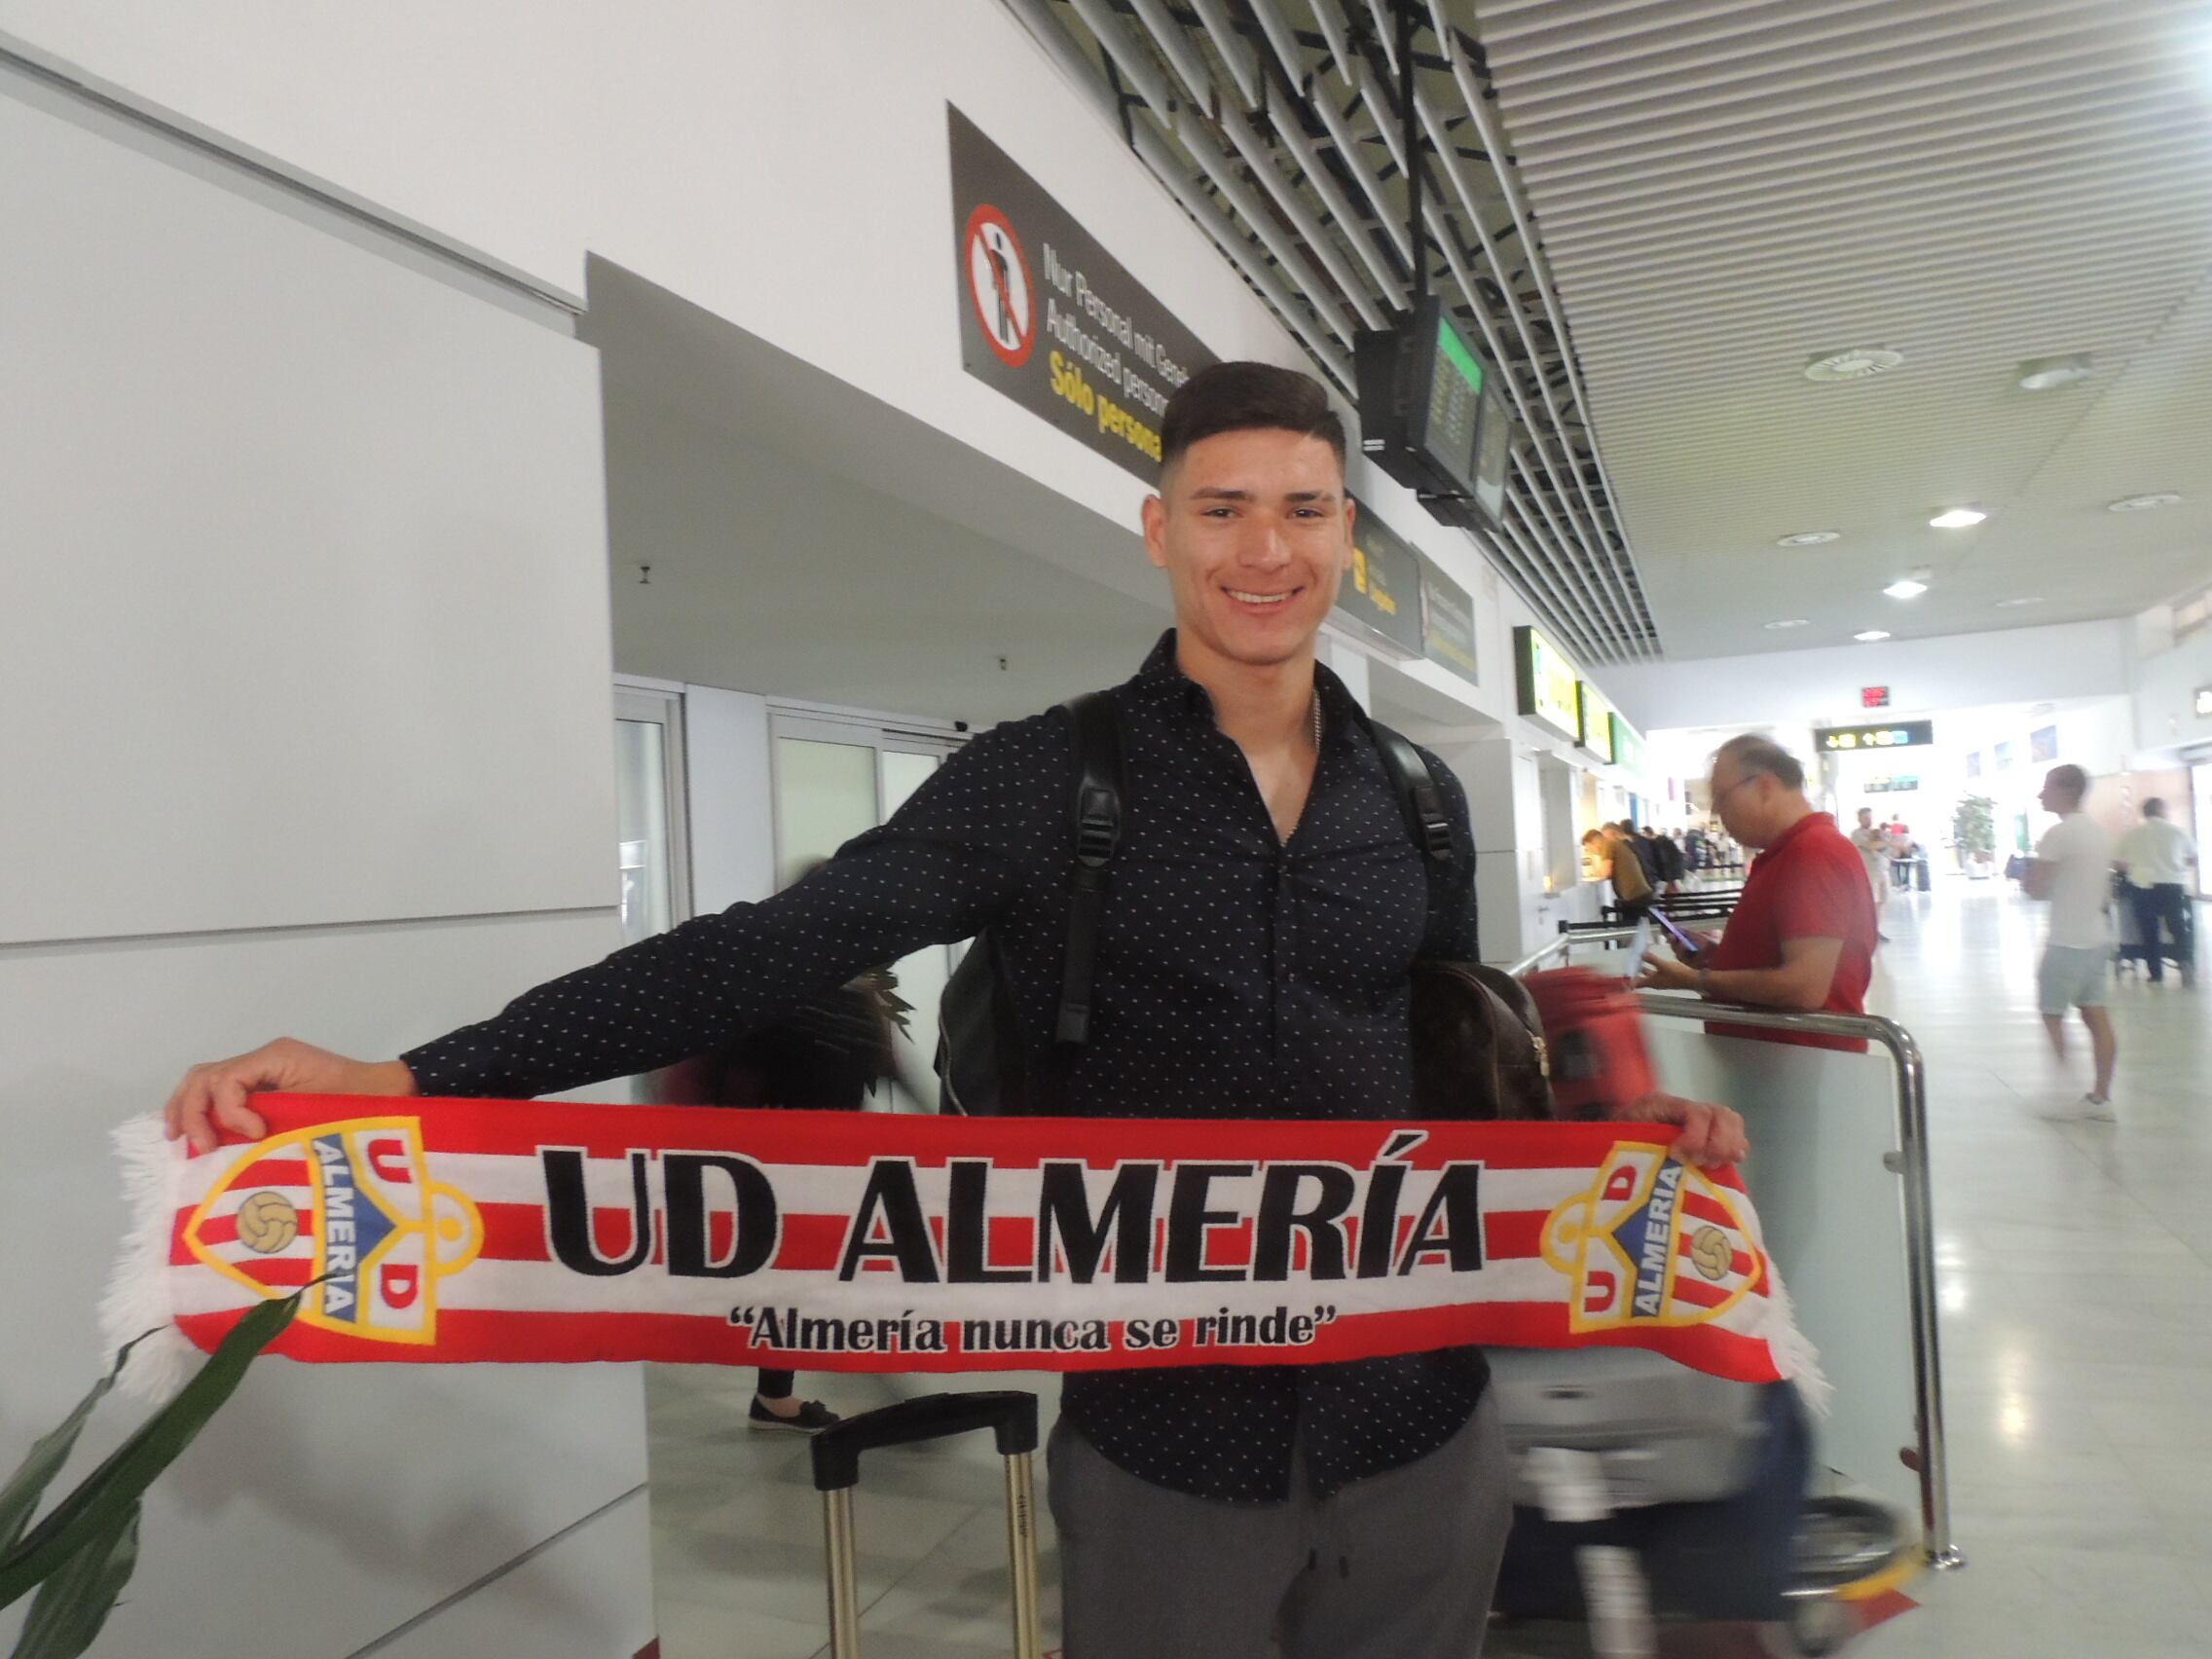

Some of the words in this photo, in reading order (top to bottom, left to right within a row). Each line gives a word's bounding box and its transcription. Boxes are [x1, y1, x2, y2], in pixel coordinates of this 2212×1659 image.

[1043, 242, 1074, 298] Nur
[1075, 270, 1133, 350] Personal
[1134, 331, 1156, 368] mit
[1156, 344, 1190, 388] Gene
[1047, 298, 1122, 386] Authorized
[1123, 366, 1168, 418] person
[1049, 350, 1095, 416] Sólo
[1097, 393, 1162, 462] persona
[313, 1140, 356, 1315] ALMERIA
[367, 1138, 413, 1184] U
[538, 1147, 781, 1280] UD
[837, 1130, 1485, 1284] ALMERÍA
[380, 1263, 419, 1309] D
[1583, 1270, 1616, 1312] U
[1601, 1164, 1638, 1201] D
[1636, 1165, 1683, 1317] ALMERIA
[729, 1306, 945, 1352] “Almería
[963, 1318, 1110, 1352] nunca
[1124, 1317, 1178, 1351] se
[1195, 1305, 1337, 1348] rinde”
